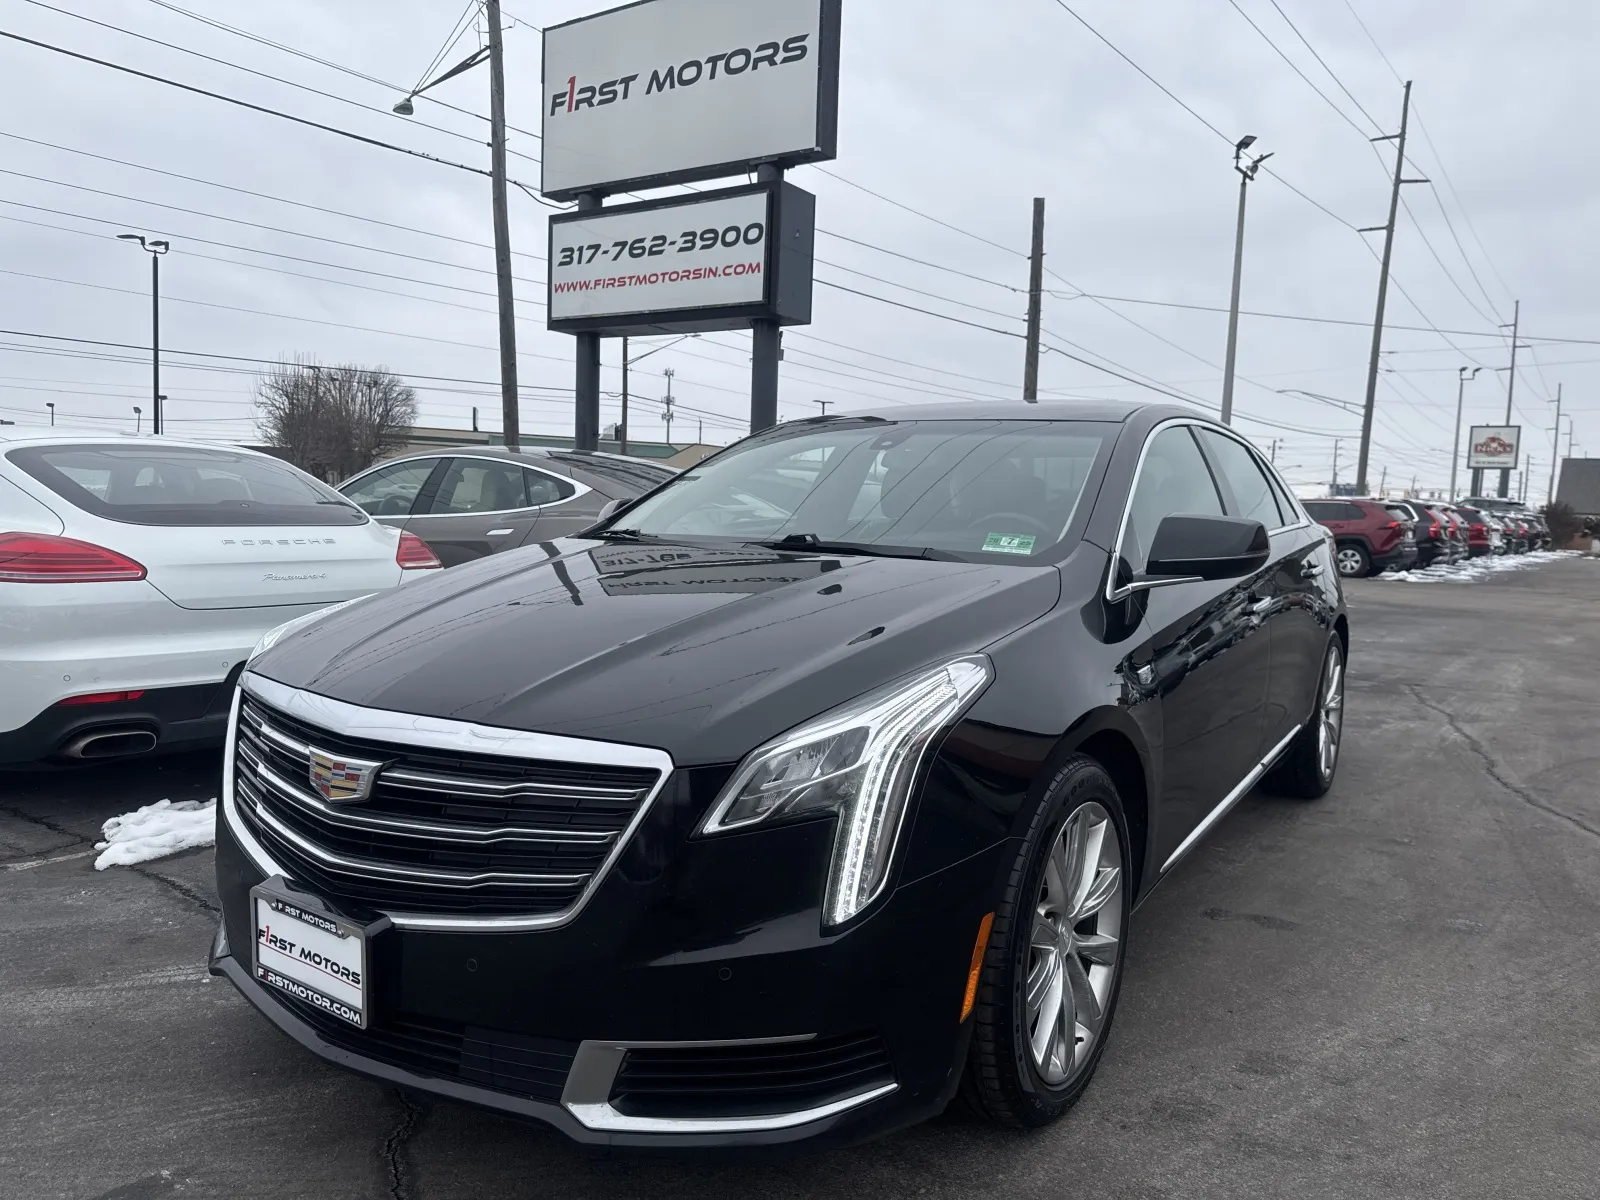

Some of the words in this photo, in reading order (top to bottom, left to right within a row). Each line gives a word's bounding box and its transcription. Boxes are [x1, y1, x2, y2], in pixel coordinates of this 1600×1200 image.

[645, 33, 810, 95] MOTORS
[557, 222, 763, 267] 317-762-3900
[554, 262, 761, 294] WWW.FIRSTMOTORSIN.COM
[301, 913, 337, 933] MOTORS
[299, 947, 361, 985] MOTORS
